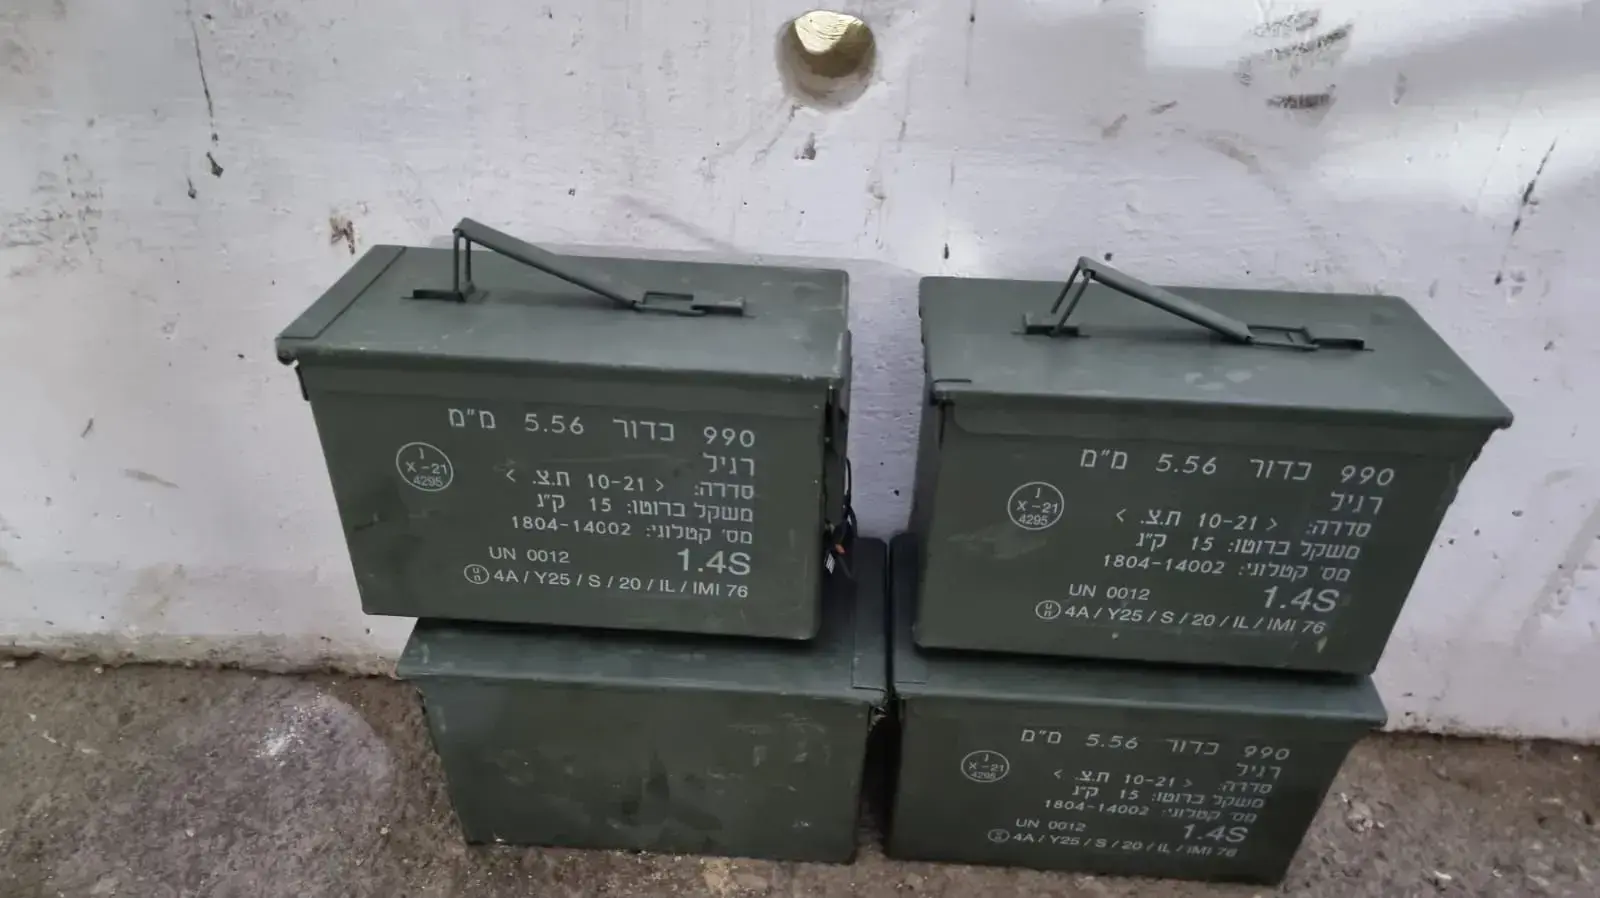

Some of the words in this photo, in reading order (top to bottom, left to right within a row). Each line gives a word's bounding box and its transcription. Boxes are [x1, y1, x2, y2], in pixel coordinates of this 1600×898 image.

[524, 413, 584, 435] 5.56
[612, 418, 674, 441] כדור
[703, 426, 755, 448] 990
[702, 452, 755, 476] רגיל
[1155, 453, 1217, 475] 5.56
[1250, 458, 1313, 481] כדור
[587, 473, 644, 492] 10-21
[1341, 465, 1395, 486] 990
[694, 481, 754, 500] סדרה:
[590, 497, 612, 512] 15
[627, 499, 686, 518] ברוטו:
[693, 501, 753, 524] משקל
[1330, 491, 1384, 515] רגיל
[511, 515, 632, 536] 1804-14002
[1199, 512, 1257, 531] 10-21
[1305, 520, 1371, 537] סדרה:
[1191, 536, 1215, 551] 15
[1228, 538, 1290, 556] ברוטו:
[1300, 540, 1360, 561] משקל
[488, 546, 517, 560] UN
[526, 549, 571, 564] 0012
[676, 548, 751, 576] 1.4S
[1104, 554, 1225, 574] 1804-14002
[726, 584, 748, 598] 76
[1068, 583, 1096, 597] UN
[1106, 586, 1150, 601] 0012
[1264, 585, 1340, 612] 1.4S
[1301, 620, 1327, 634] 76
